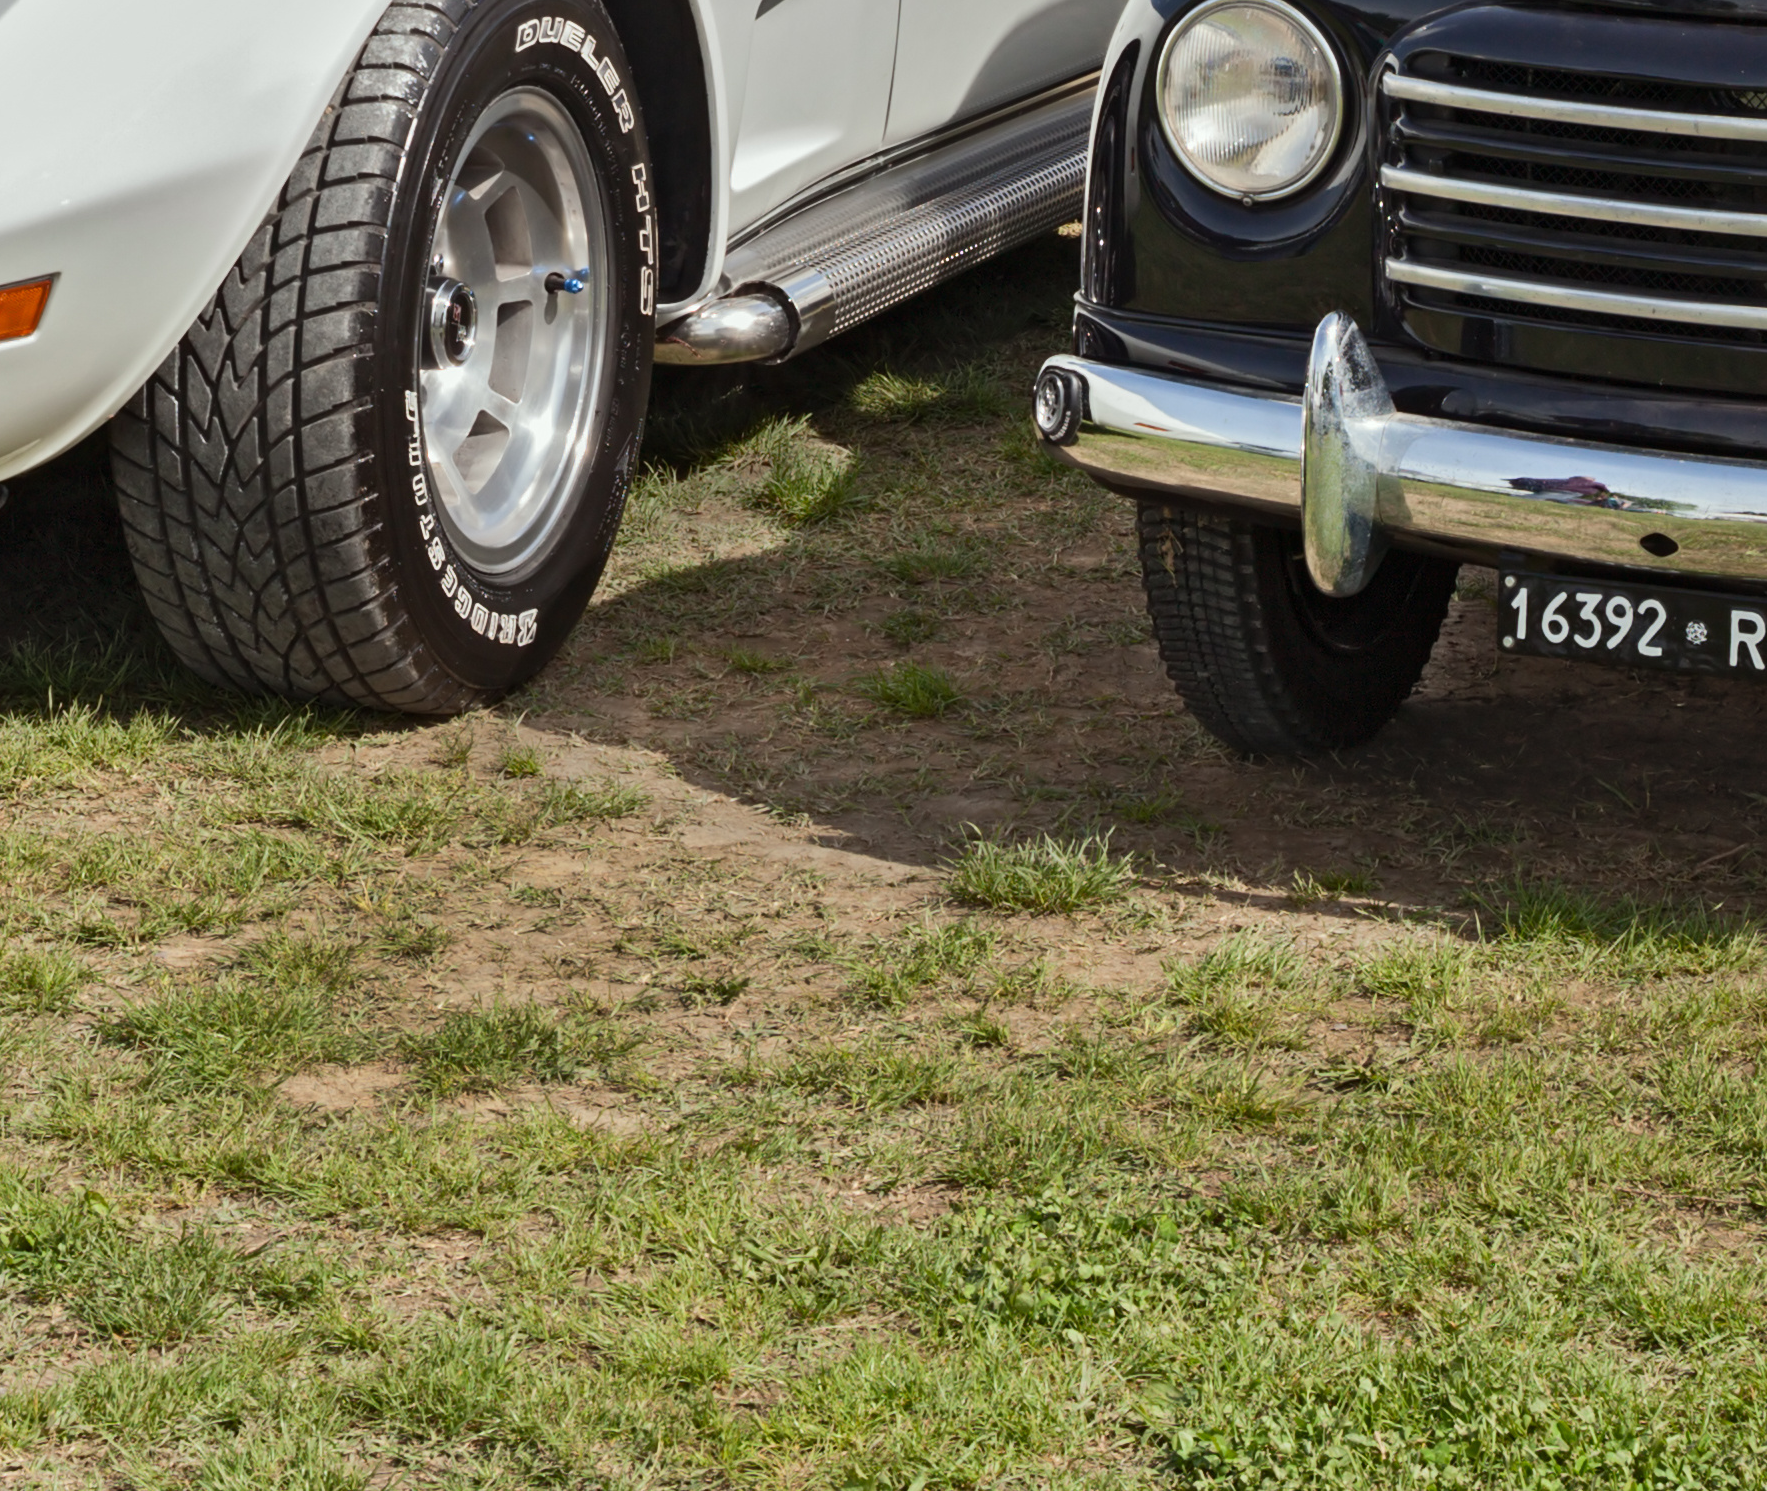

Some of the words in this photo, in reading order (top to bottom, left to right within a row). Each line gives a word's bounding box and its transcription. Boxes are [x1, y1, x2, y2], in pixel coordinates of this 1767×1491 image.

[514, 15, 635, 135] DUELER
[631, 162, 654, 317] HTS
[404, 389, 539, 648] BRIDGESTONE
[1510, 587, 1668, 658] 16392
